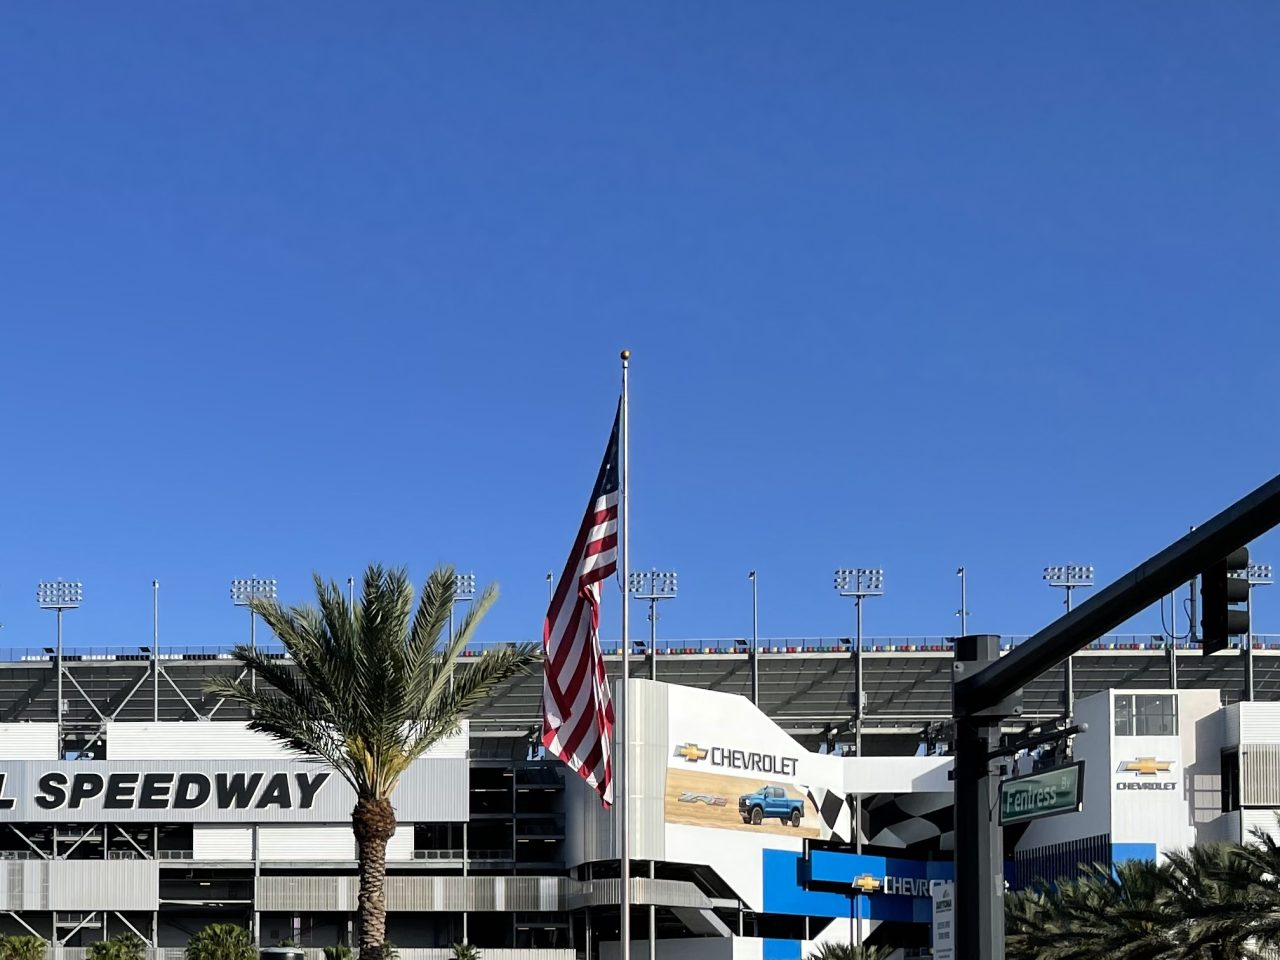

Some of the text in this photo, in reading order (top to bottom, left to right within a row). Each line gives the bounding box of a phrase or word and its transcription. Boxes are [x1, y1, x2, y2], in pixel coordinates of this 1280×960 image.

[711, 747, 799, 776] CHEVROLET
[34, 772, 332, 811] SPEEDWAY
[1007, 785, 1057, 813] Fentress
[1116, 782, 1177, 791] CHEVROLET
